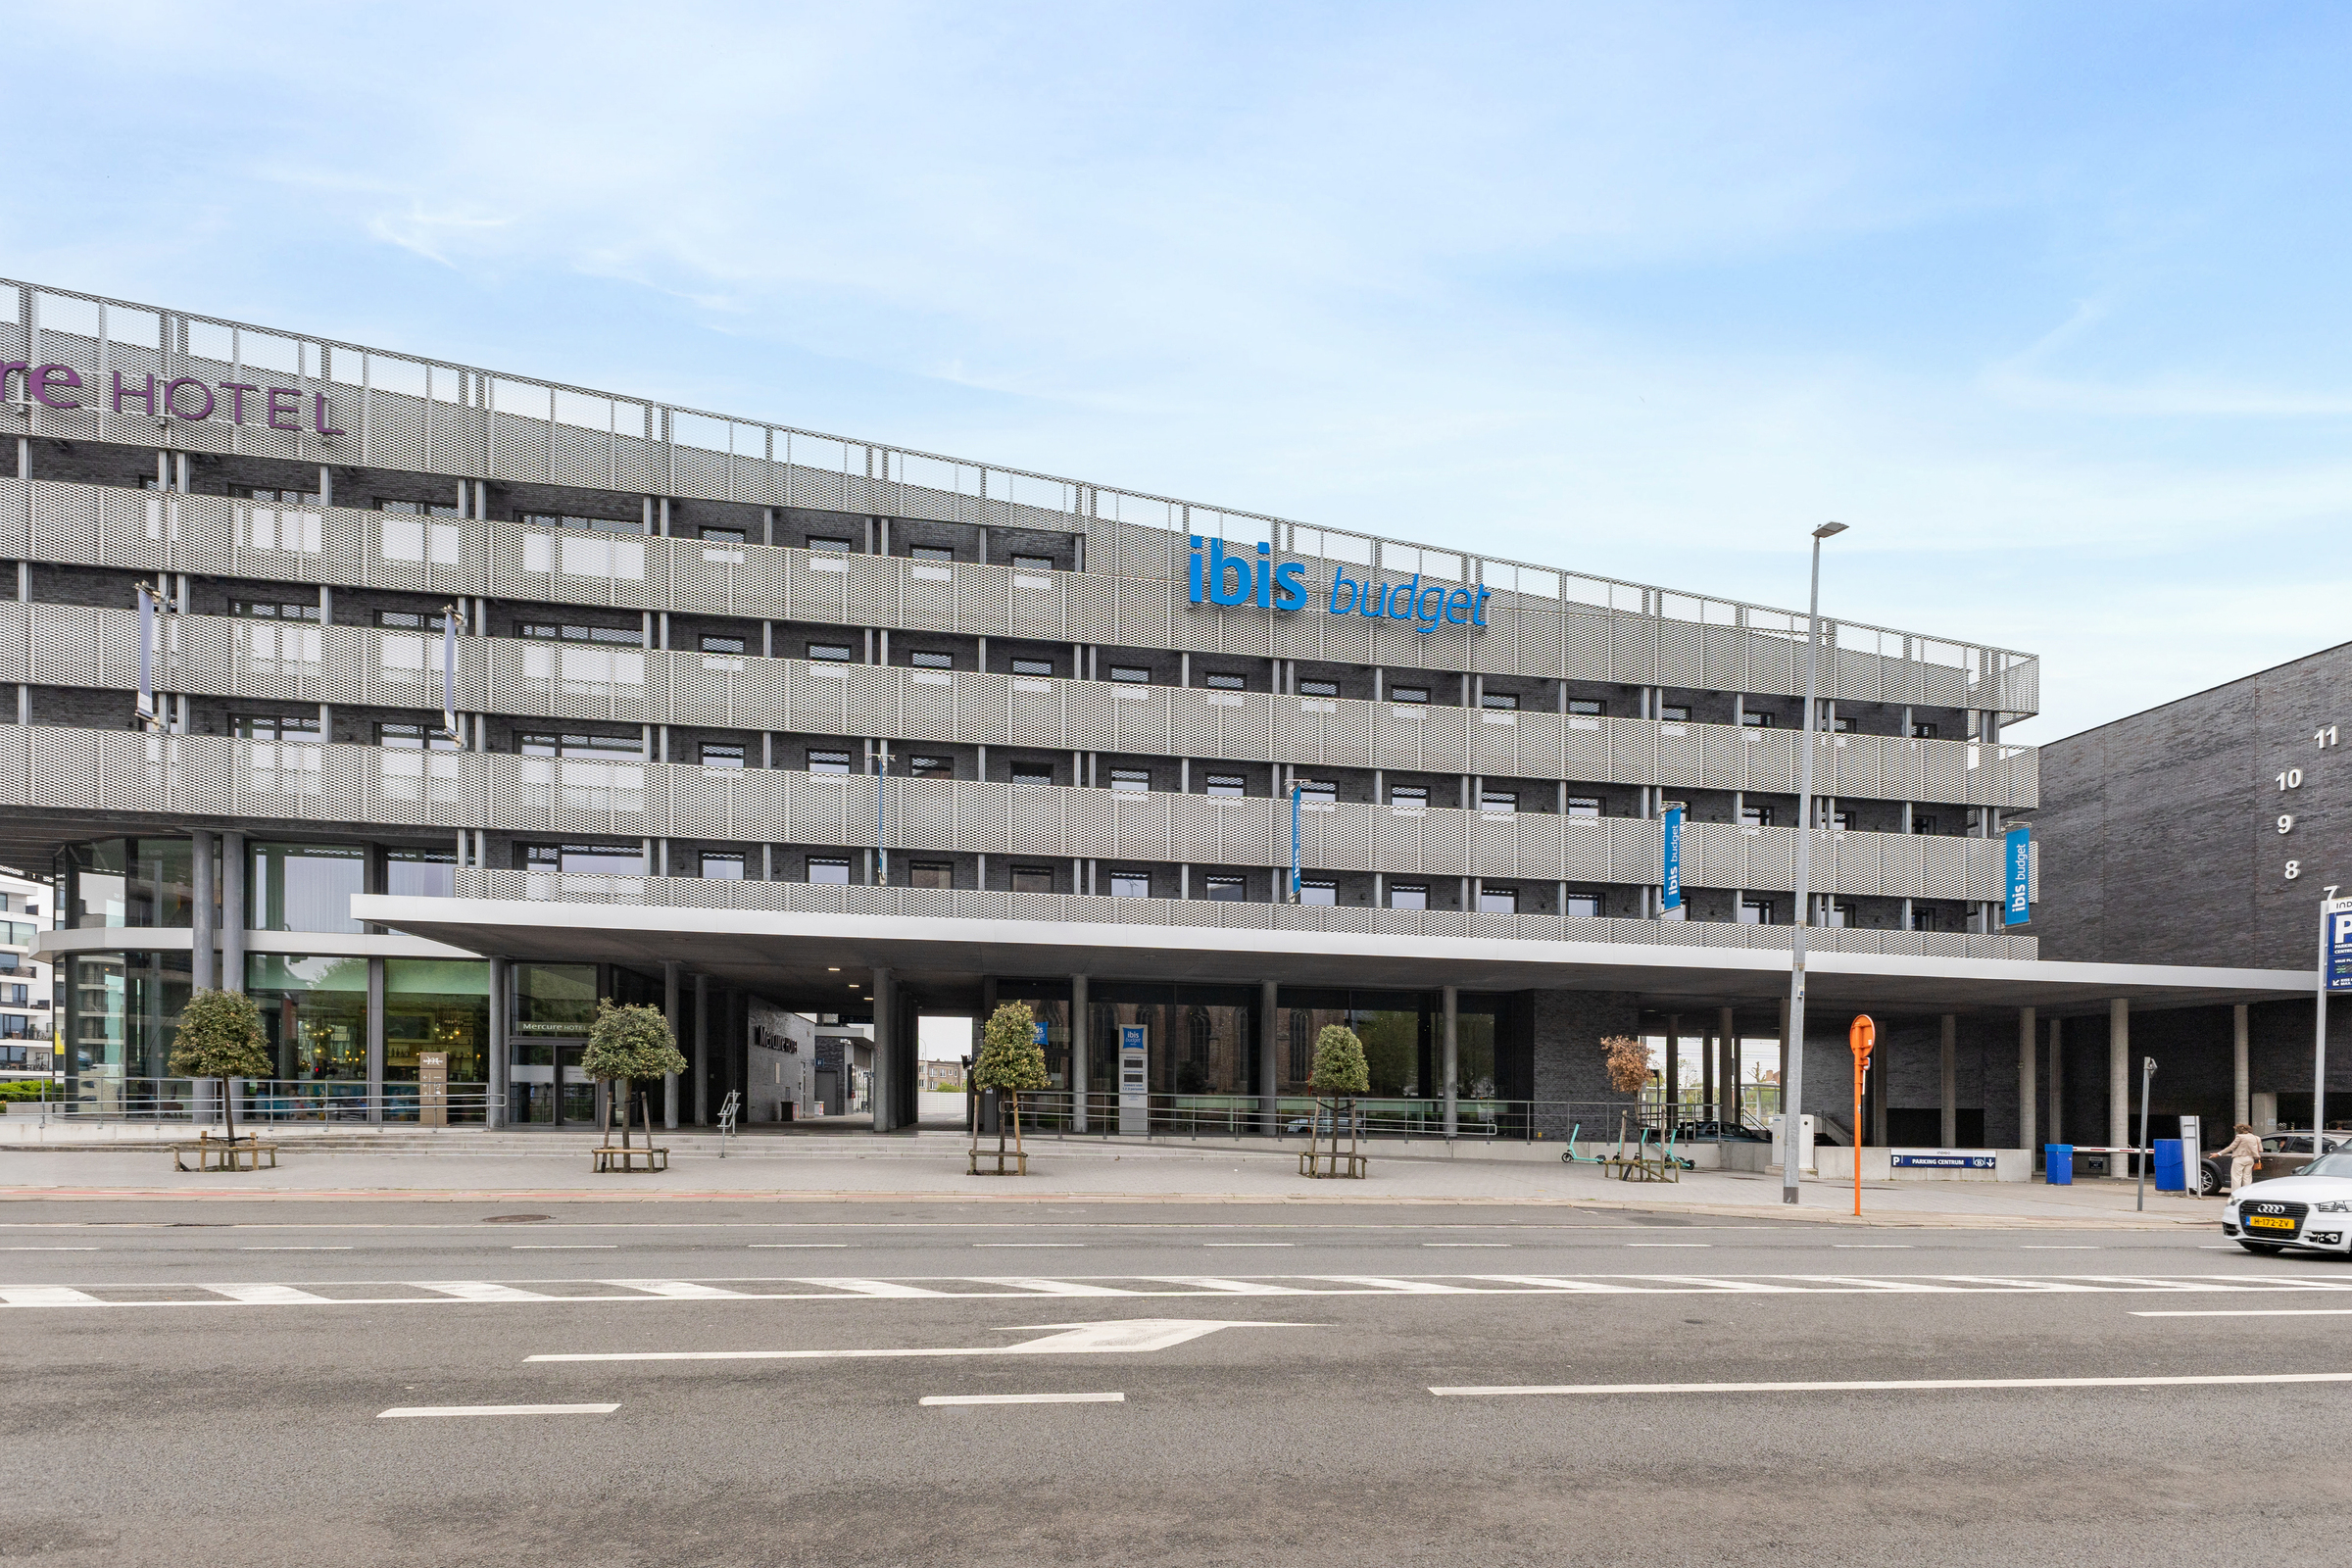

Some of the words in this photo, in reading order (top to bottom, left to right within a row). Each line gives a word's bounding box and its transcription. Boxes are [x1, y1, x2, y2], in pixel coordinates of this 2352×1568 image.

[113, 369, 345, 435] HOTEL
[1190, 535, 1308, 612] ibis
[1329, 565, 1492, 633] budget
[2314, 725, 2338, 749] 11
[2276, 768, 2303, 791] 10
[2278, 814, 2294, 834] 9
[1670, 824, 1680, 862] budget
[2015, 844, 2028, 880] budget
[2284, 859, 2301, 880] 8
[1668, 865, 1679, 896] ibis
[2323, 885, 2340, 901] 7
[2012, 884, 2026, 912] ibis
[2334, 913, 2352, 944] P
[1892, 1156, 1900, 1165] P
[2254, 1218, 2289, 1227] H-172-ZV
